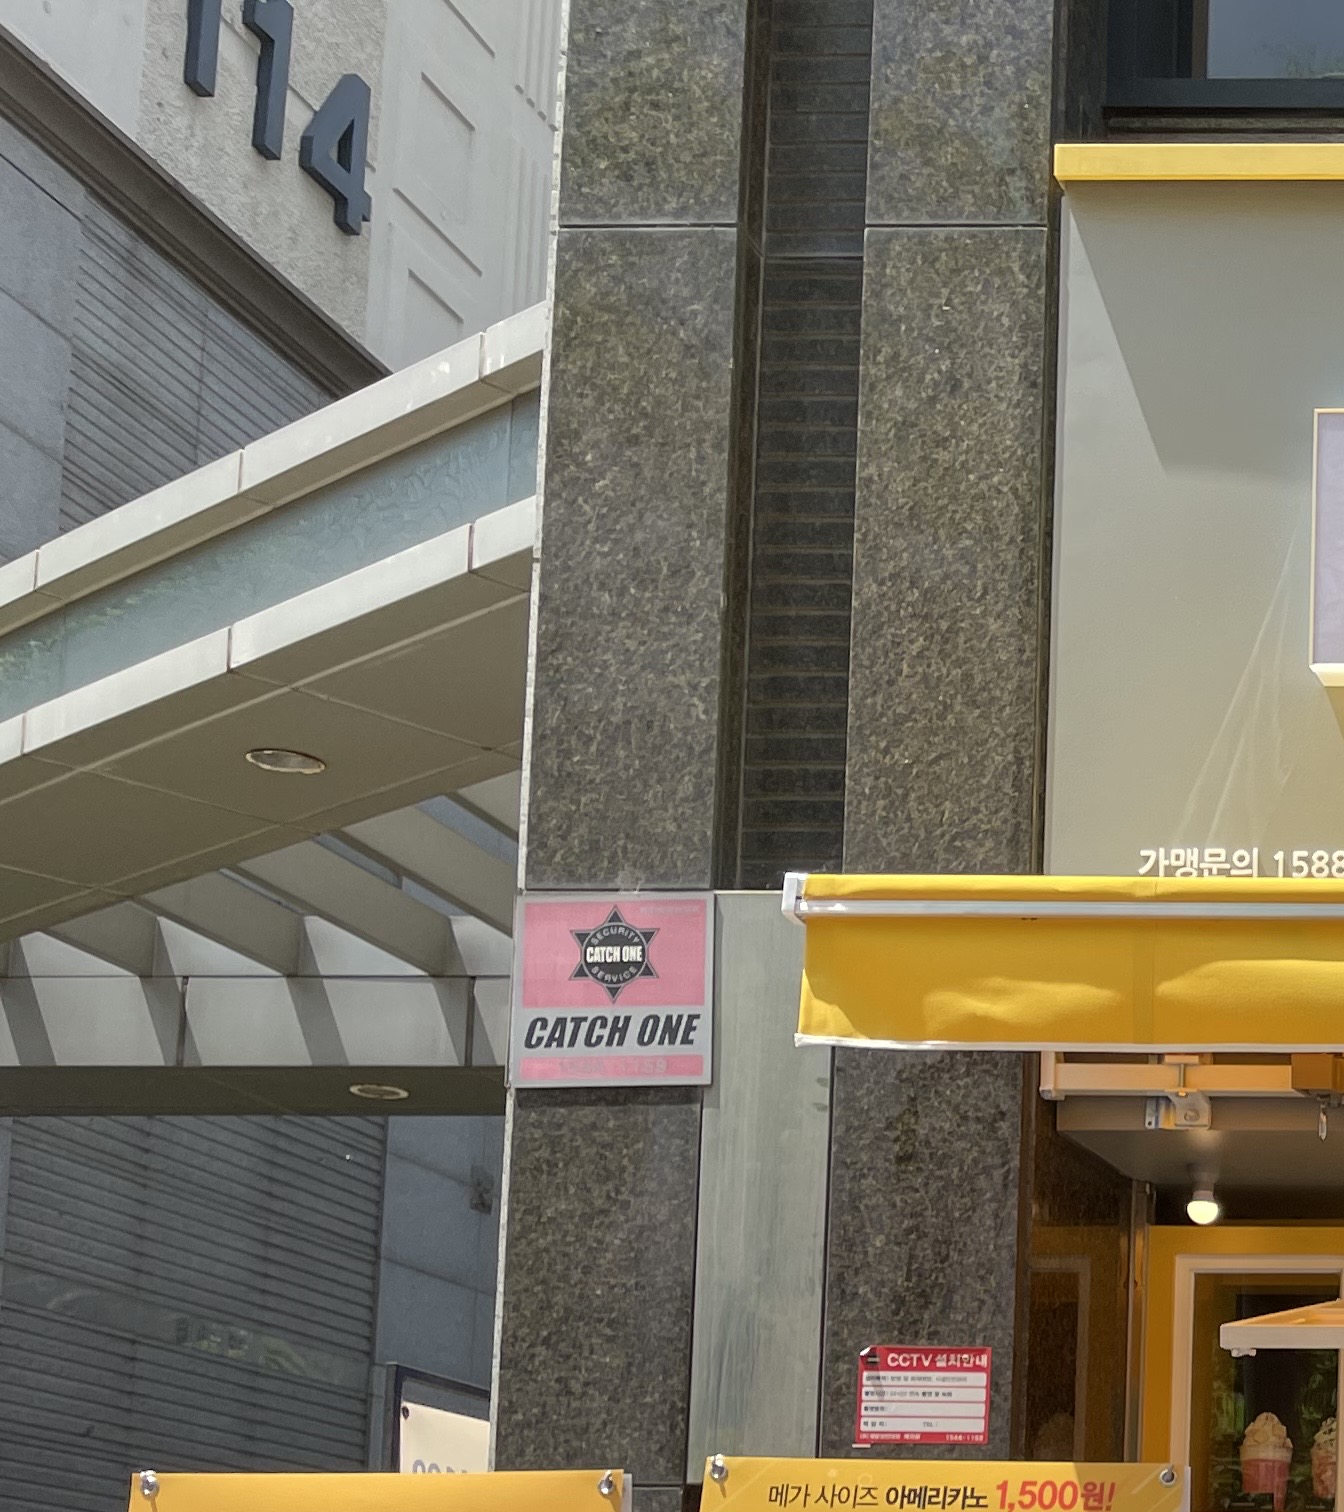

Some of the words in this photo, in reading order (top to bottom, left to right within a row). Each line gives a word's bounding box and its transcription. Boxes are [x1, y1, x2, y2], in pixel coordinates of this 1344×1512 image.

[1138, 847, 1259, 879] 가맹문의
[590, 926, 640, 945] SECURITY
[586, 946, 620, 963] CATCH
[622, 945, 643, 962] ONE
[524, 1015, 632, 1050] CATCH
[636, 1013, 701, 1047] ONE
[887, 1353, 933, 1367] CCTV
[768, 1483, 811, 1509] 메가
[814, 1483, 879, 1509] 사이즈
[885, 1483, 989, 1510] 아메리카노
